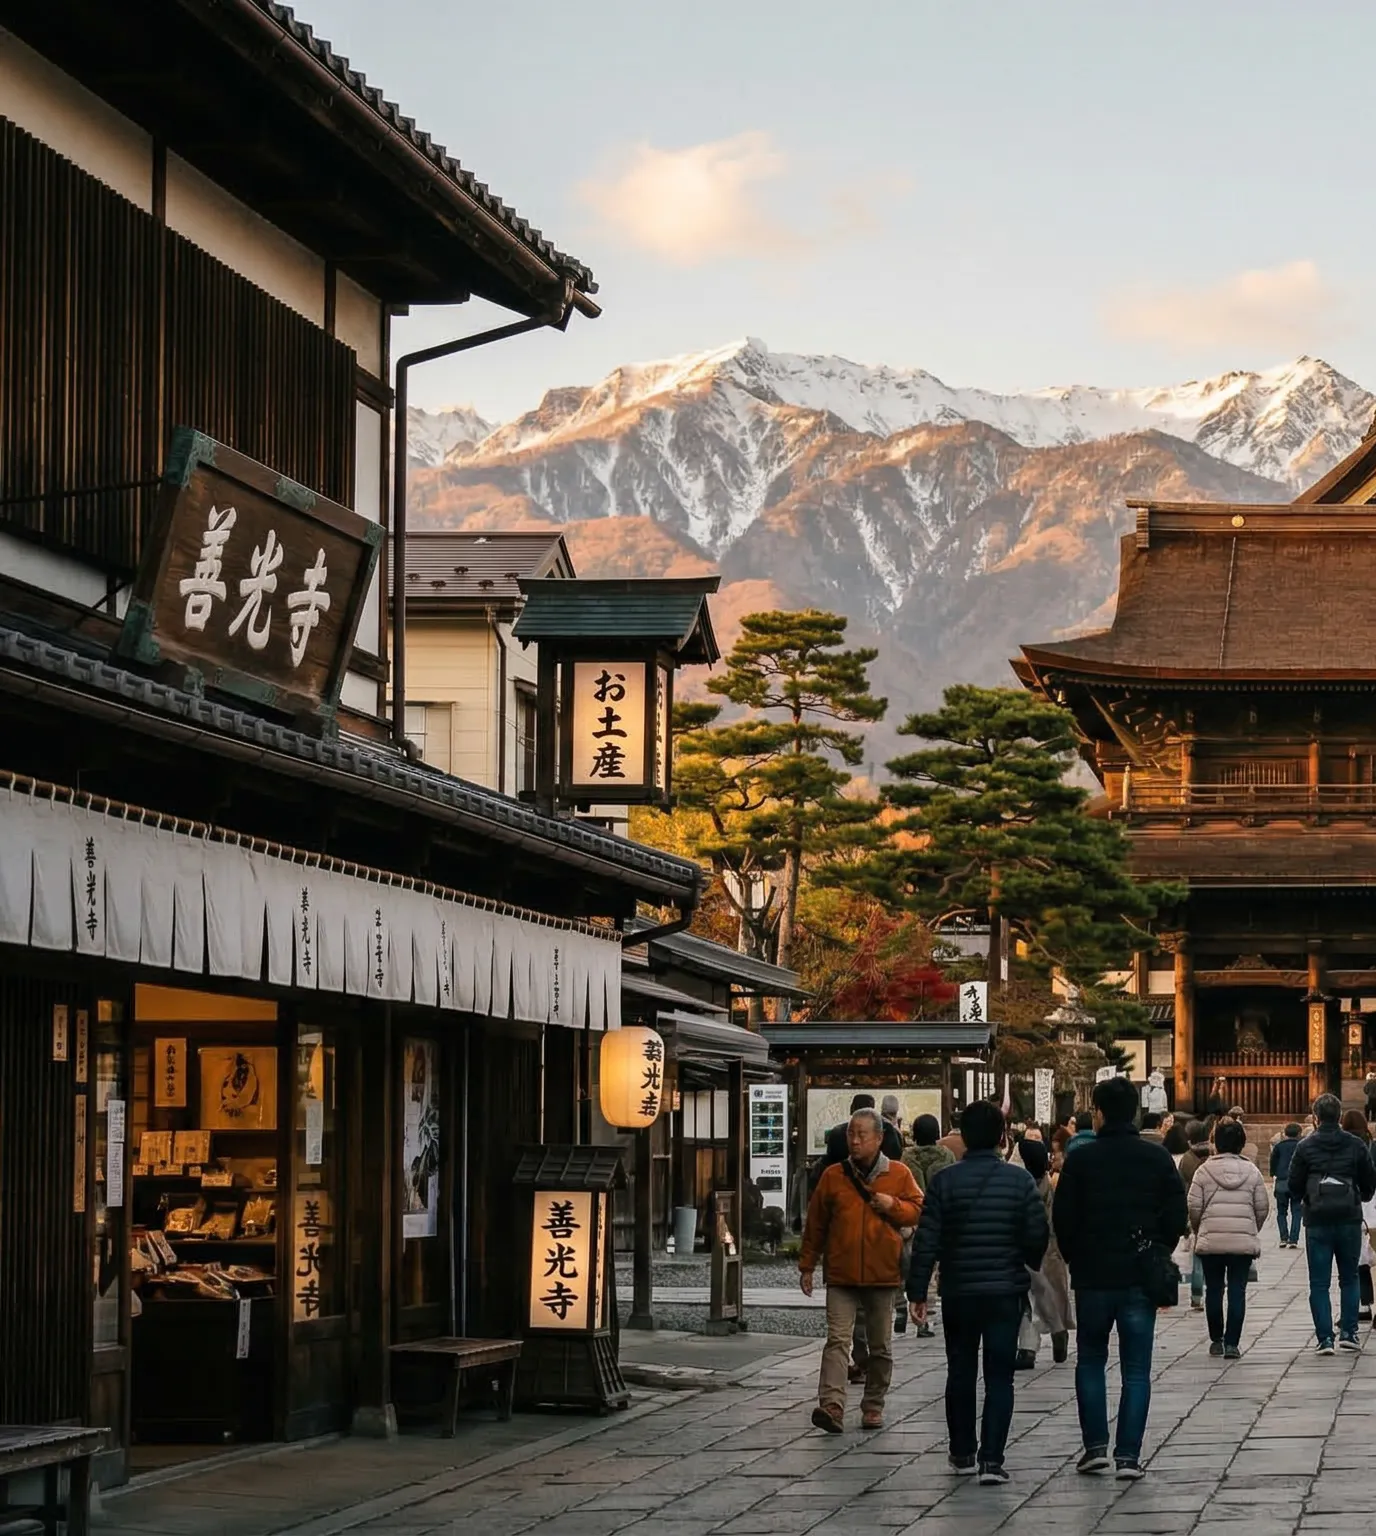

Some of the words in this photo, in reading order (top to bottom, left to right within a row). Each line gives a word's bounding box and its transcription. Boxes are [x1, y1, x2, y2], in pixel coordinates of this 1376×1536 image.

[179, 505, 331, 668] 善光寺
[589, 669, 628, 779] お土産
[539, 1200, 581, 1320] 善光寺
